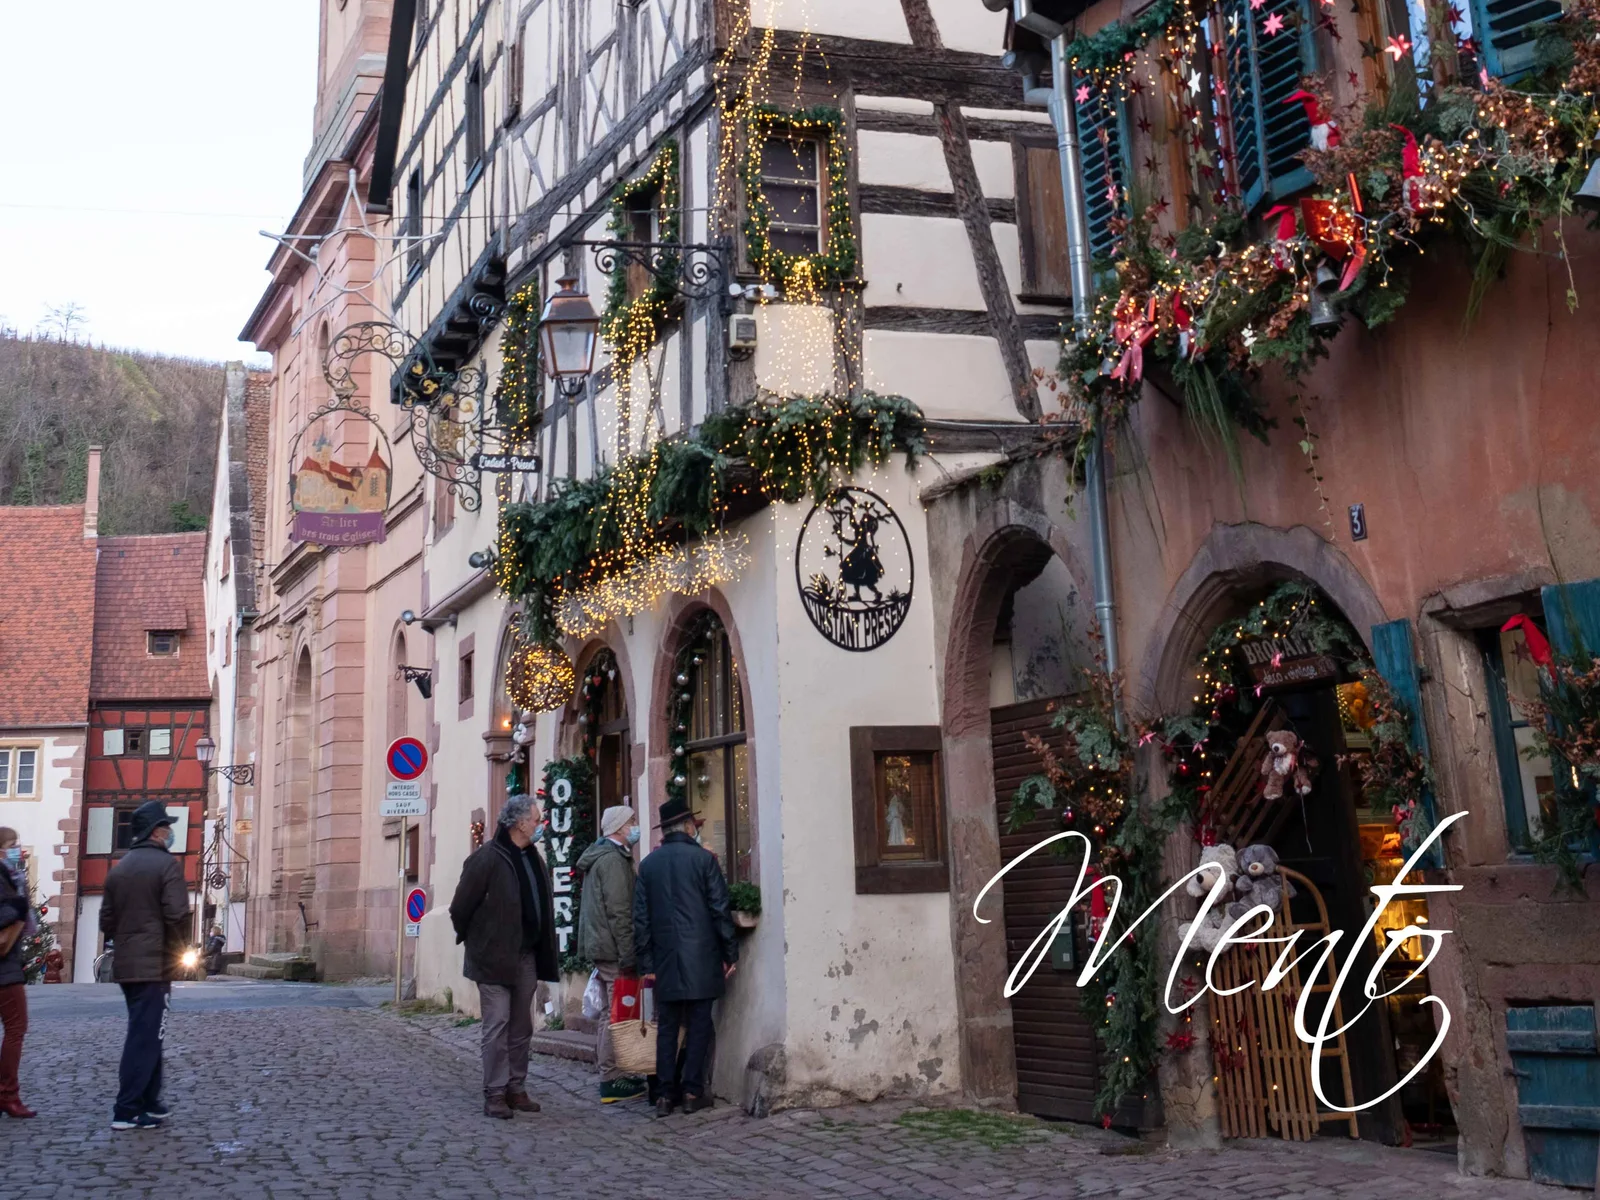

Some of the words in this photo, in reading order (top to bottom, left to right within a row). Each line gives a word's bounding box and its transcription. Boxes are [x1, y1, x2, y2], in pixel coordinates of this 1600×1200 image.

[321, 516, 358, 528] Atlier
[1351, 511, 1361, 534] 3
[318, 531, 340, 542] trois
[551, 778, 574, 953] OUVERT
